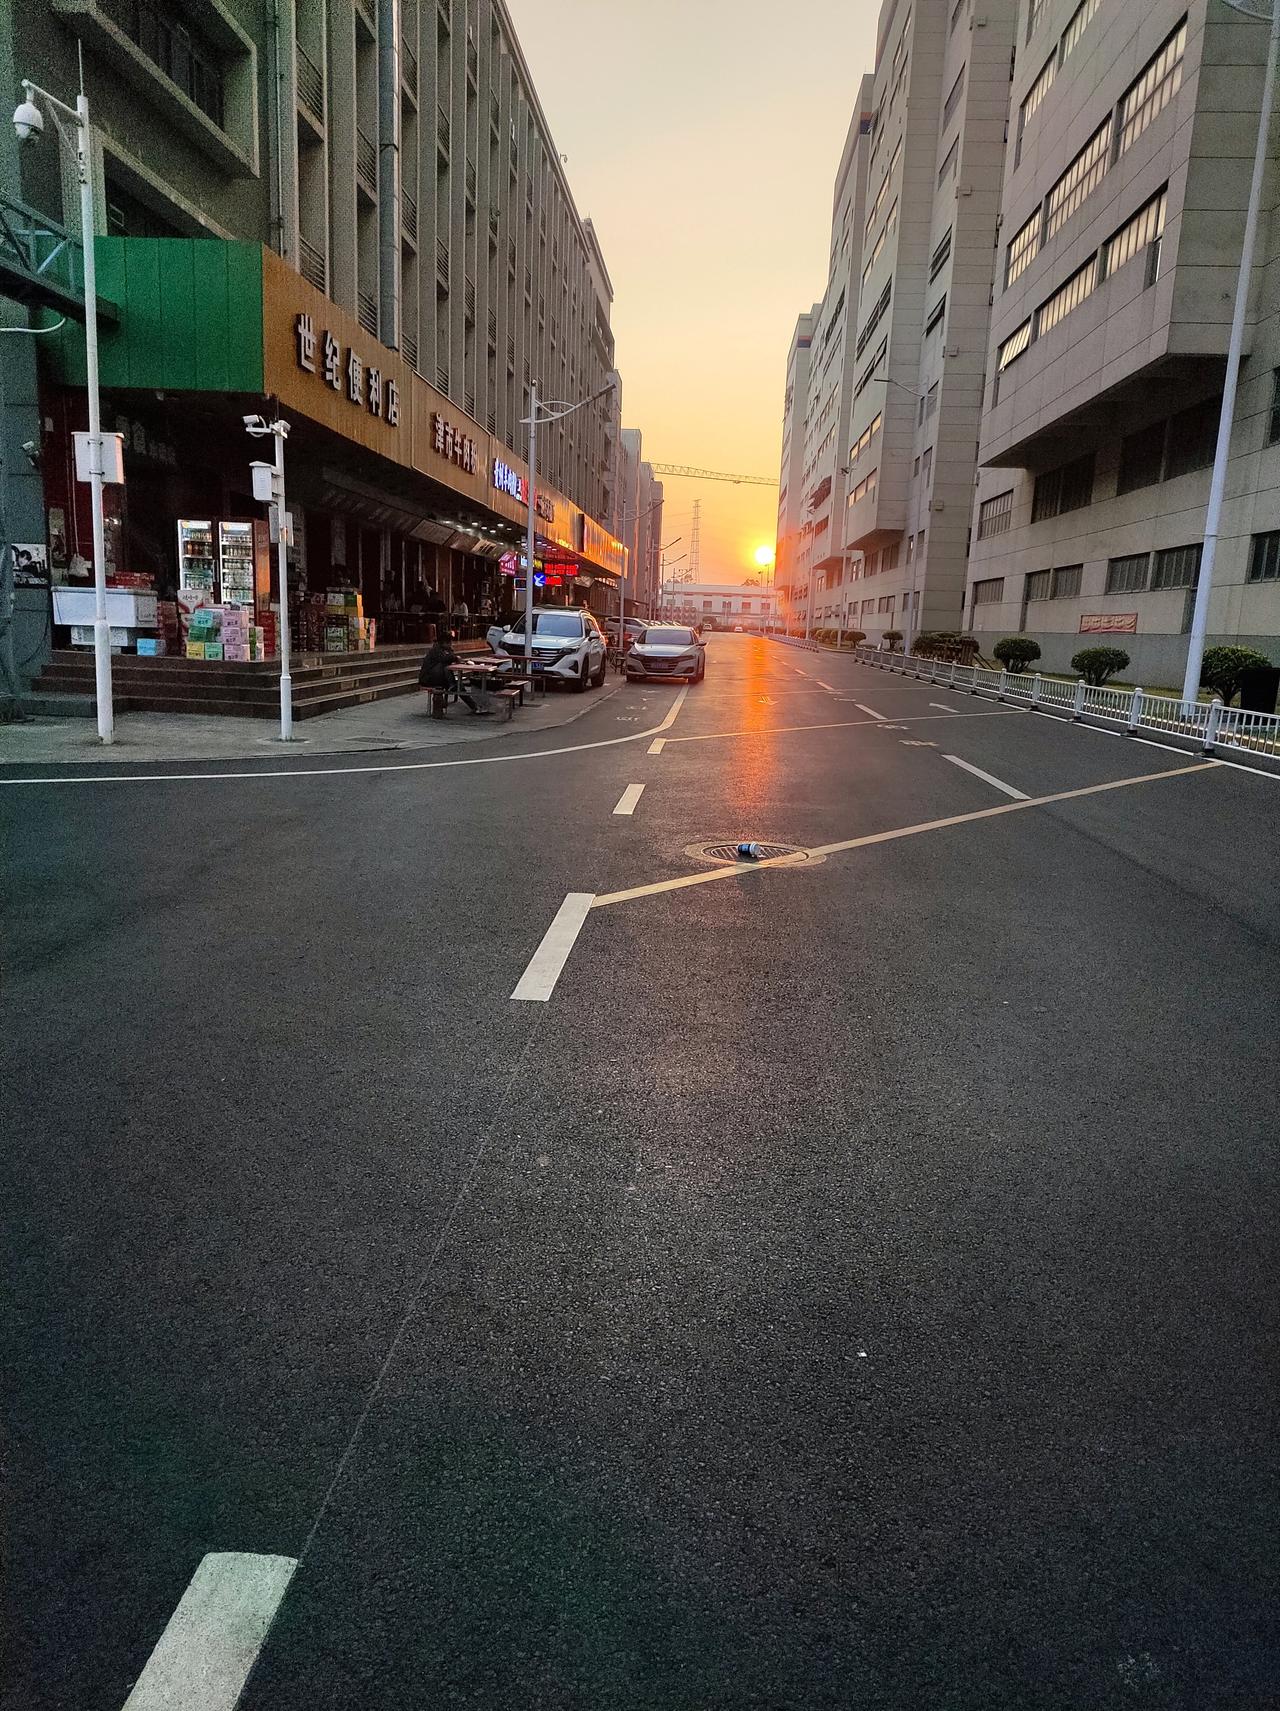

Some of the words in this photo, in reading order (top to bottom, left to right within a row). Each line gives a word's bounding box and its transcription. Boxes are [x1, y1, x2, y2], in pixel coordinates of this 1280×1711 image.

[295, 312, 400, 427] 世纪便利店
